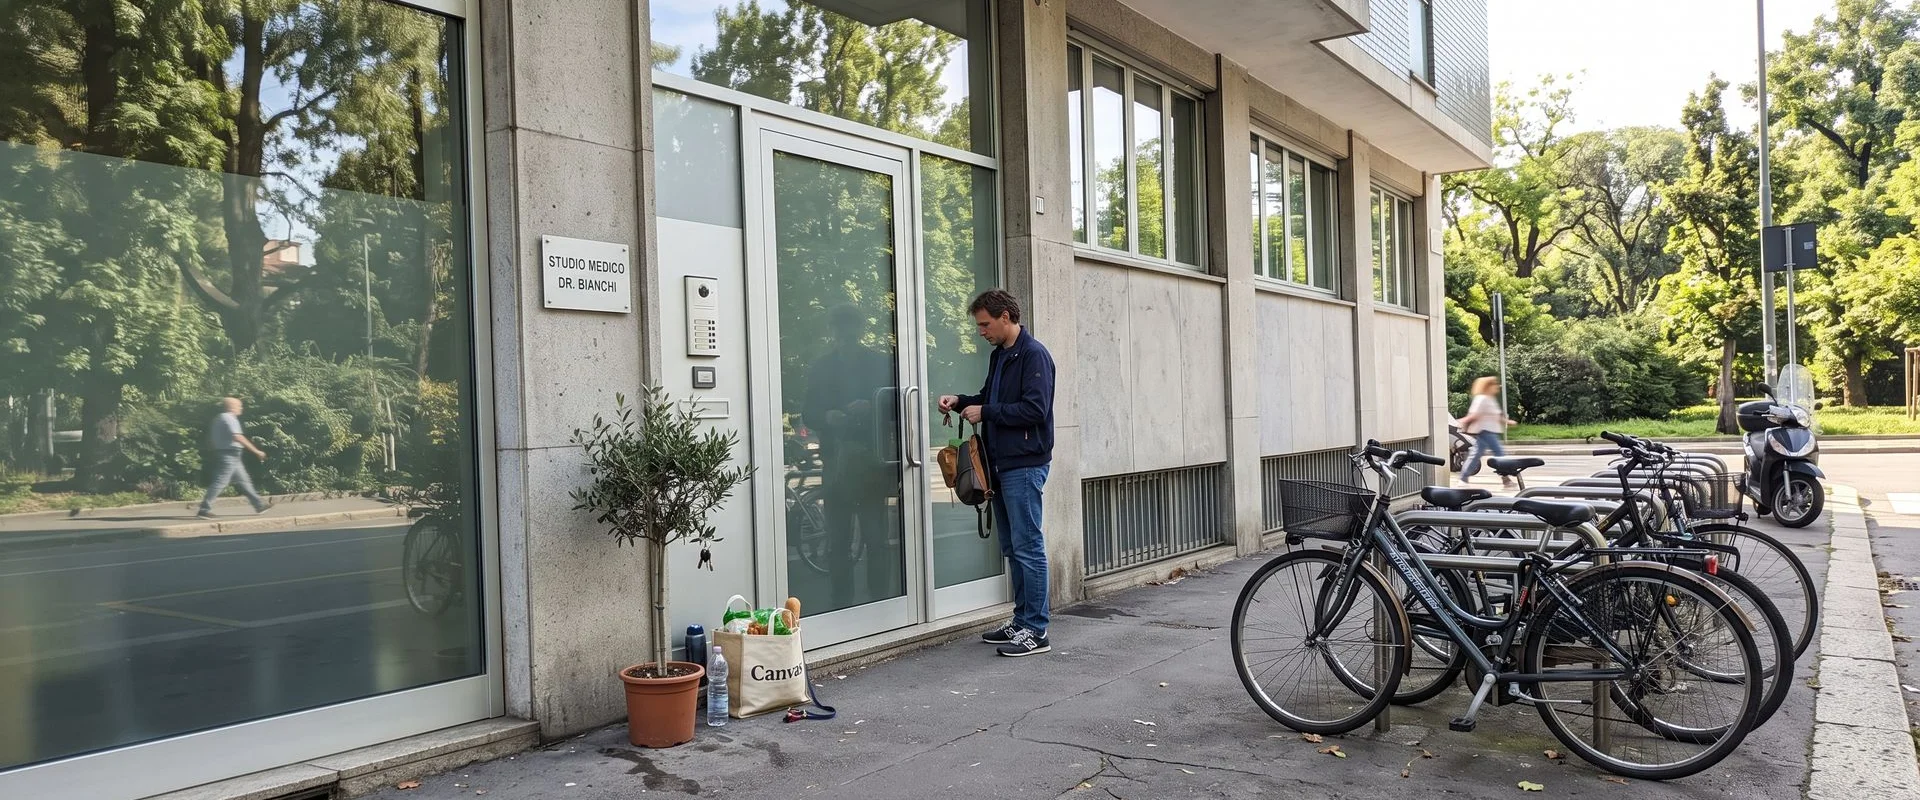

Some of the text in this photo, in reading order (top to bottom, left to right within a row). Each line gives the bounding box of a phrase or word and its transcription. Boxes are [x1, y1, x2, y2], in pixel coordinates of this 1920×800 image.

[549, 255, 625, 274] STUDIO MEDICO
[558, 277, 617, 293] DR. BIANCHI
[1023, 638, 1038, 651] N
[751, 662, 803, 681] Canvas
